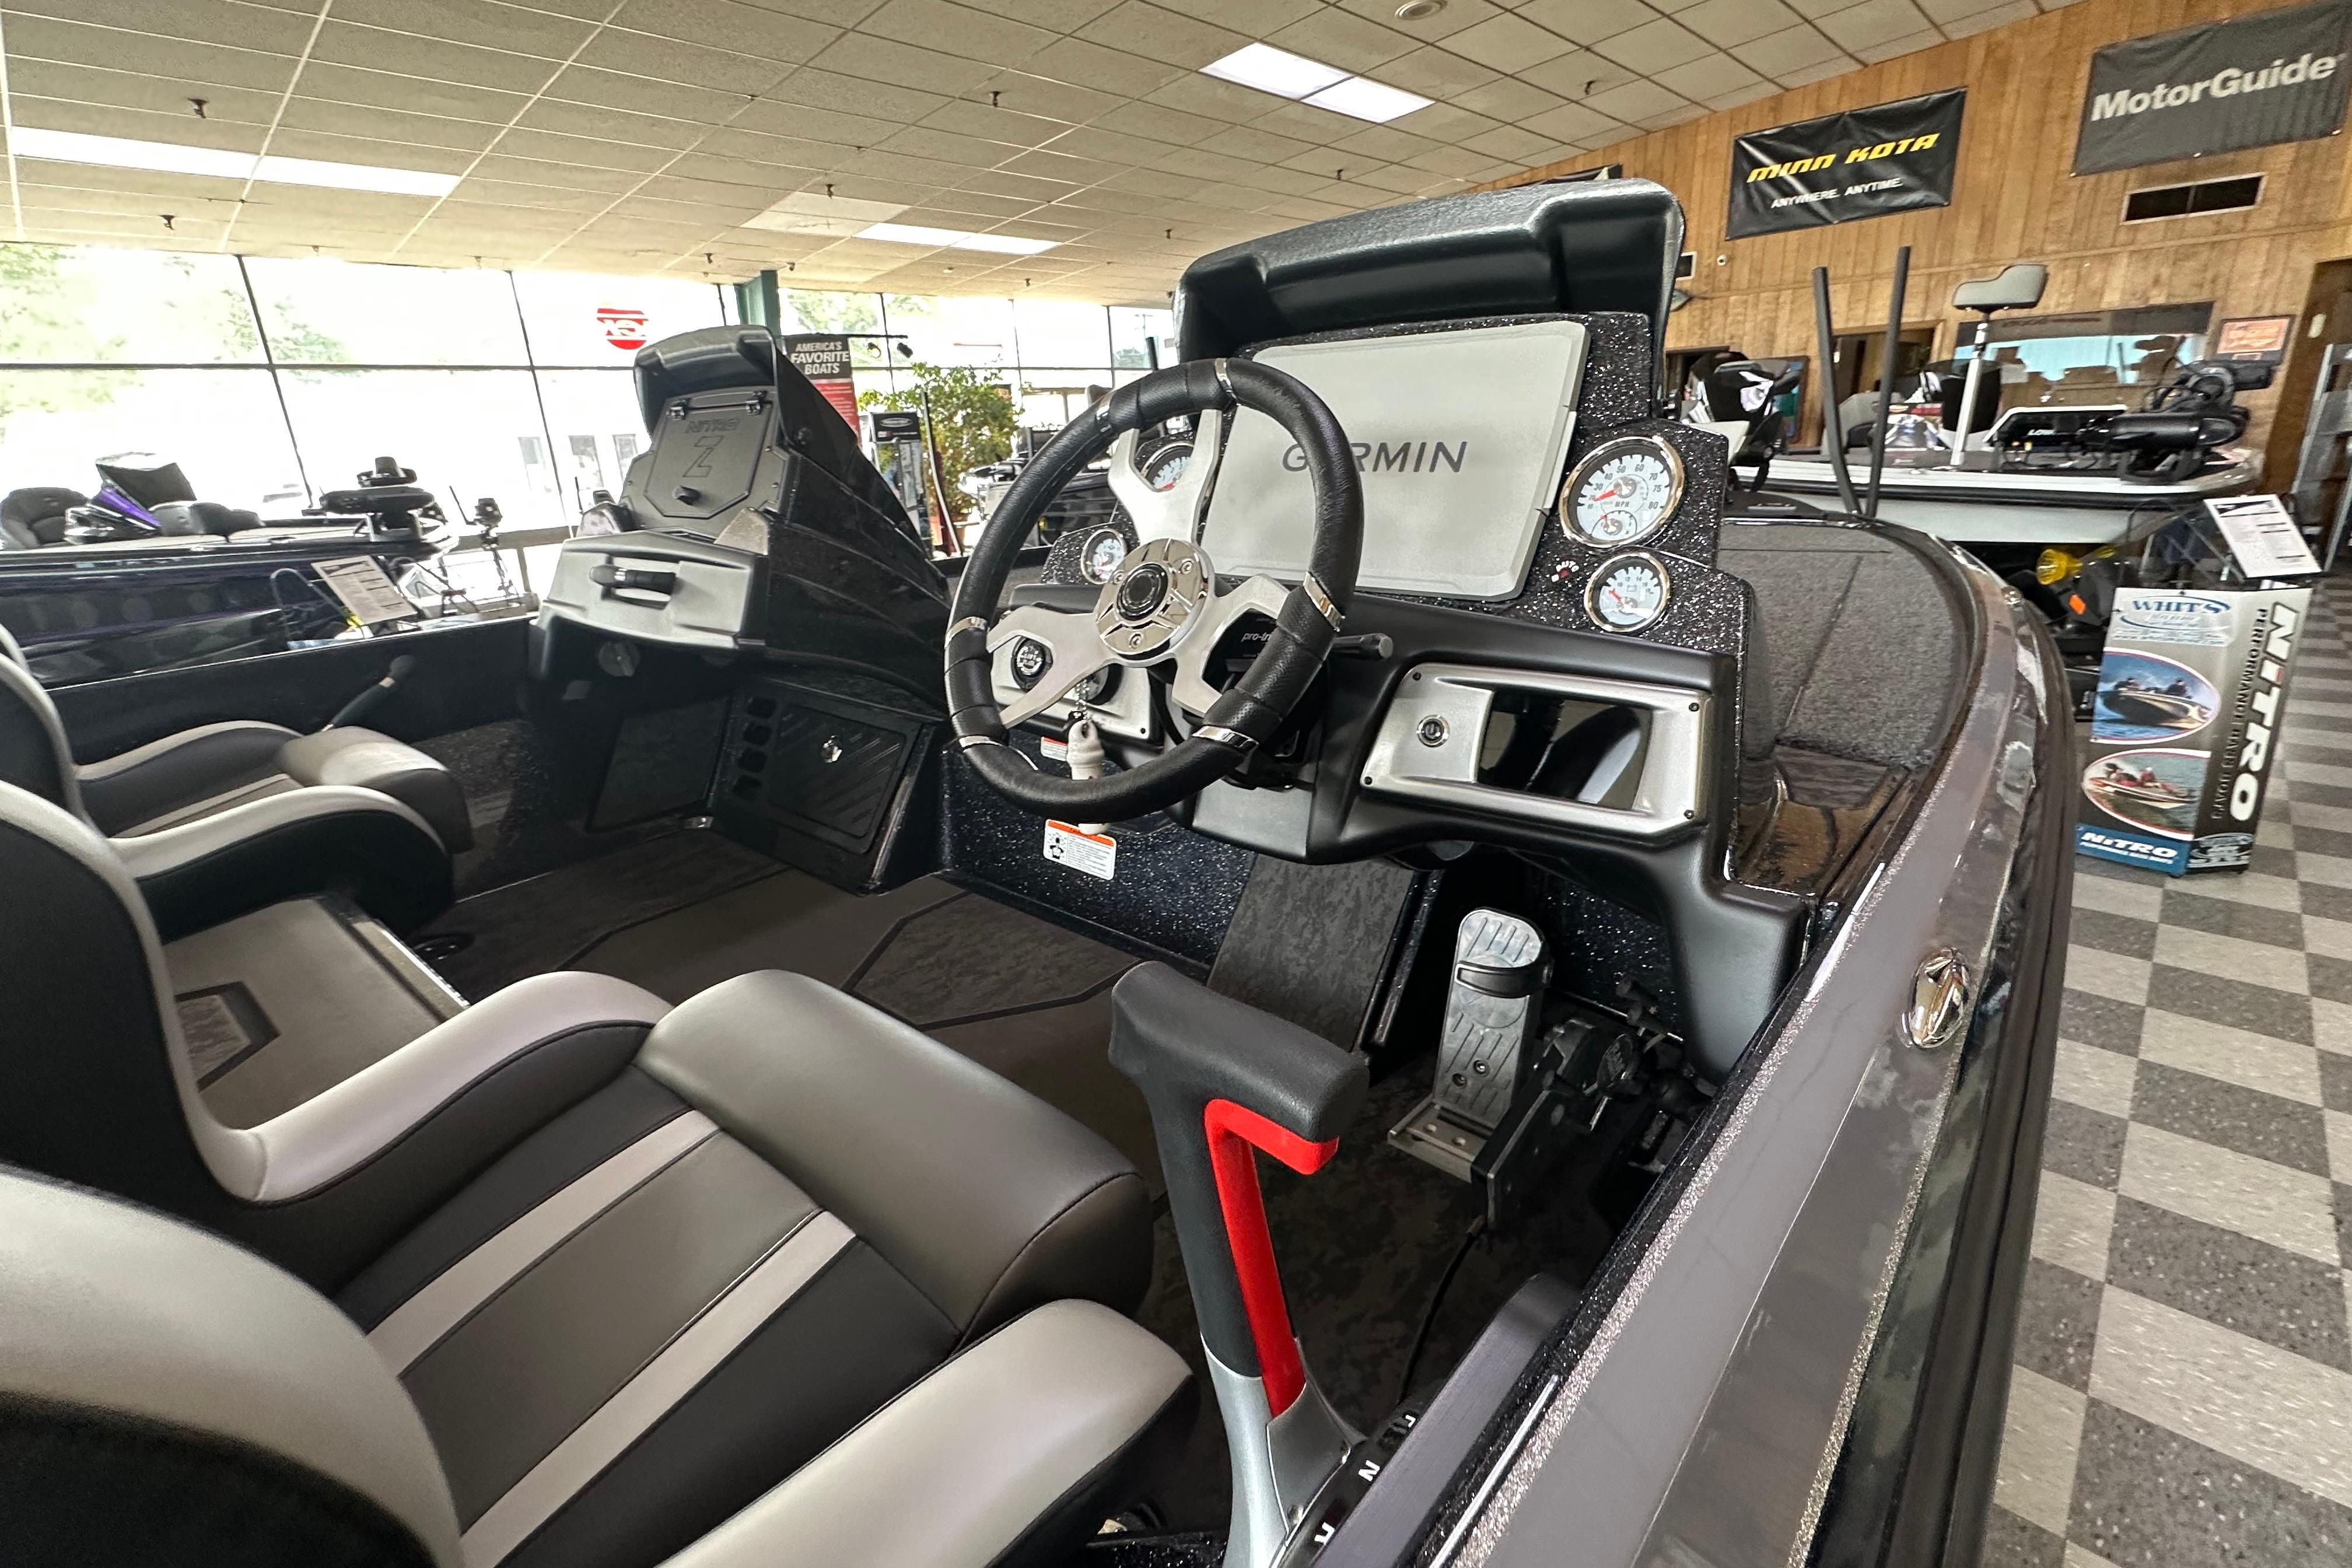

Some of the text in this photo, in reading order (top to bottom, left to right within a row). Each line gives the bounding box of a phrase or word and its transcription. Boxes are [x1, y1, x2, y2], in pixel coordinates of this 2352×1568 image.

[2090, 52, 2337, 121] MotorGuide
[1746, 132, 1940, 183] MINN KOTA
[790, 351, 850, 363] FAVORITE
[804, 363, 840, 374] BOATS
[1282, 441, 1468, 473] GRMIN
[1648, 473, 1658, 481] 70
